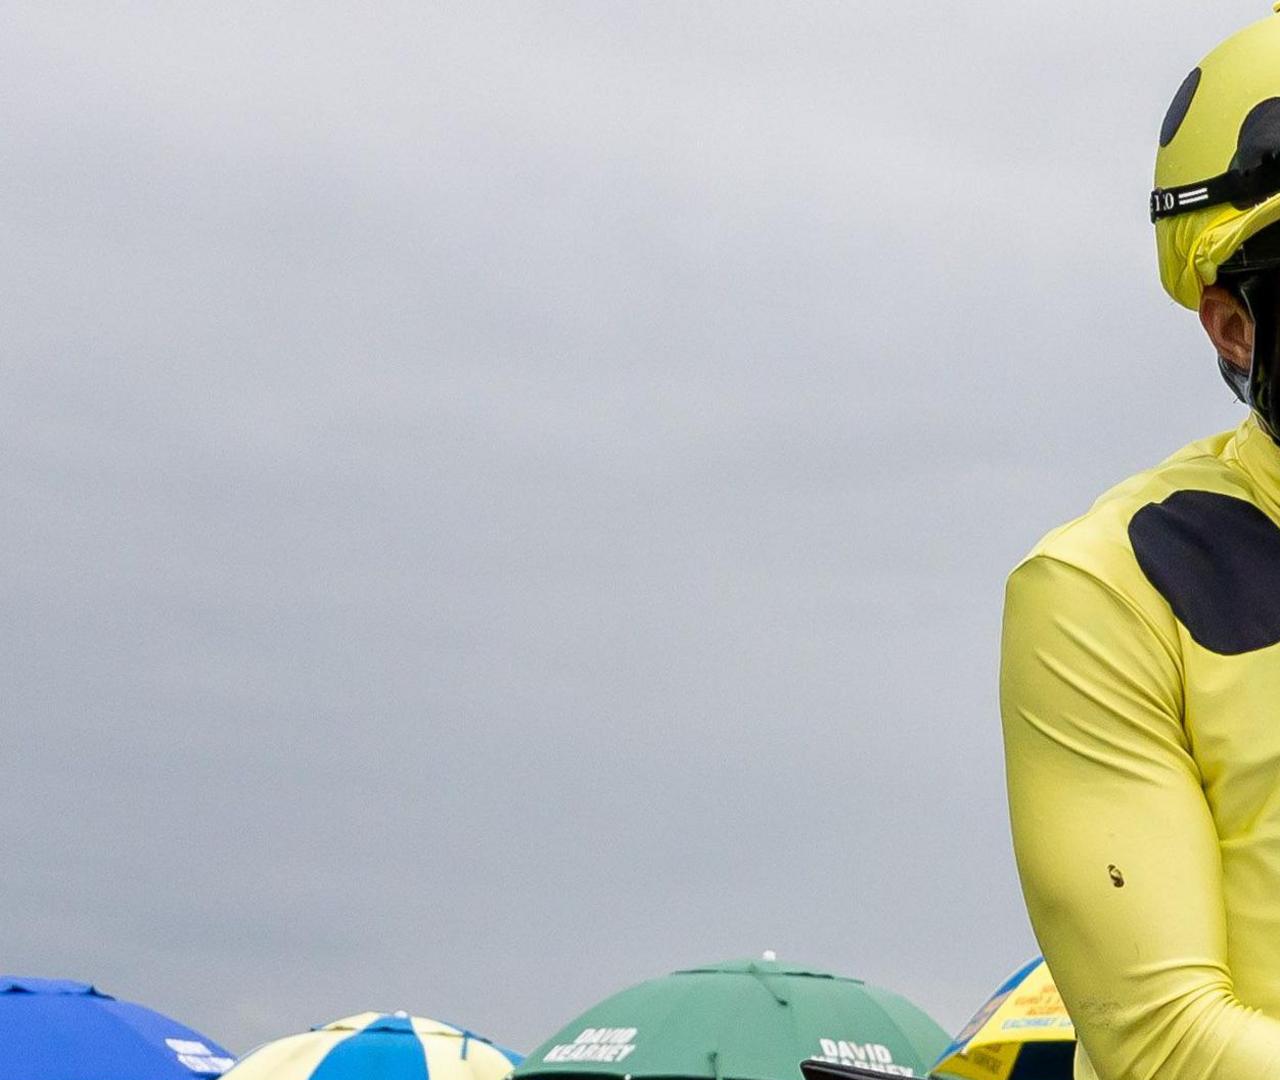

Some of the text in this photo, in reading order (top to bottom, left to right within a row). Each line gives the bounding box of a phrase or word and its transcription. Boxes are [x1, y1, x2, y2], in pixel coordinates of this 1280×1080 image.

[573, 1027, 638, 1044] DAVID
[542, 1043, 637, 1063] KEARNEY
[819, 1037, 893, 1064] DAVID
